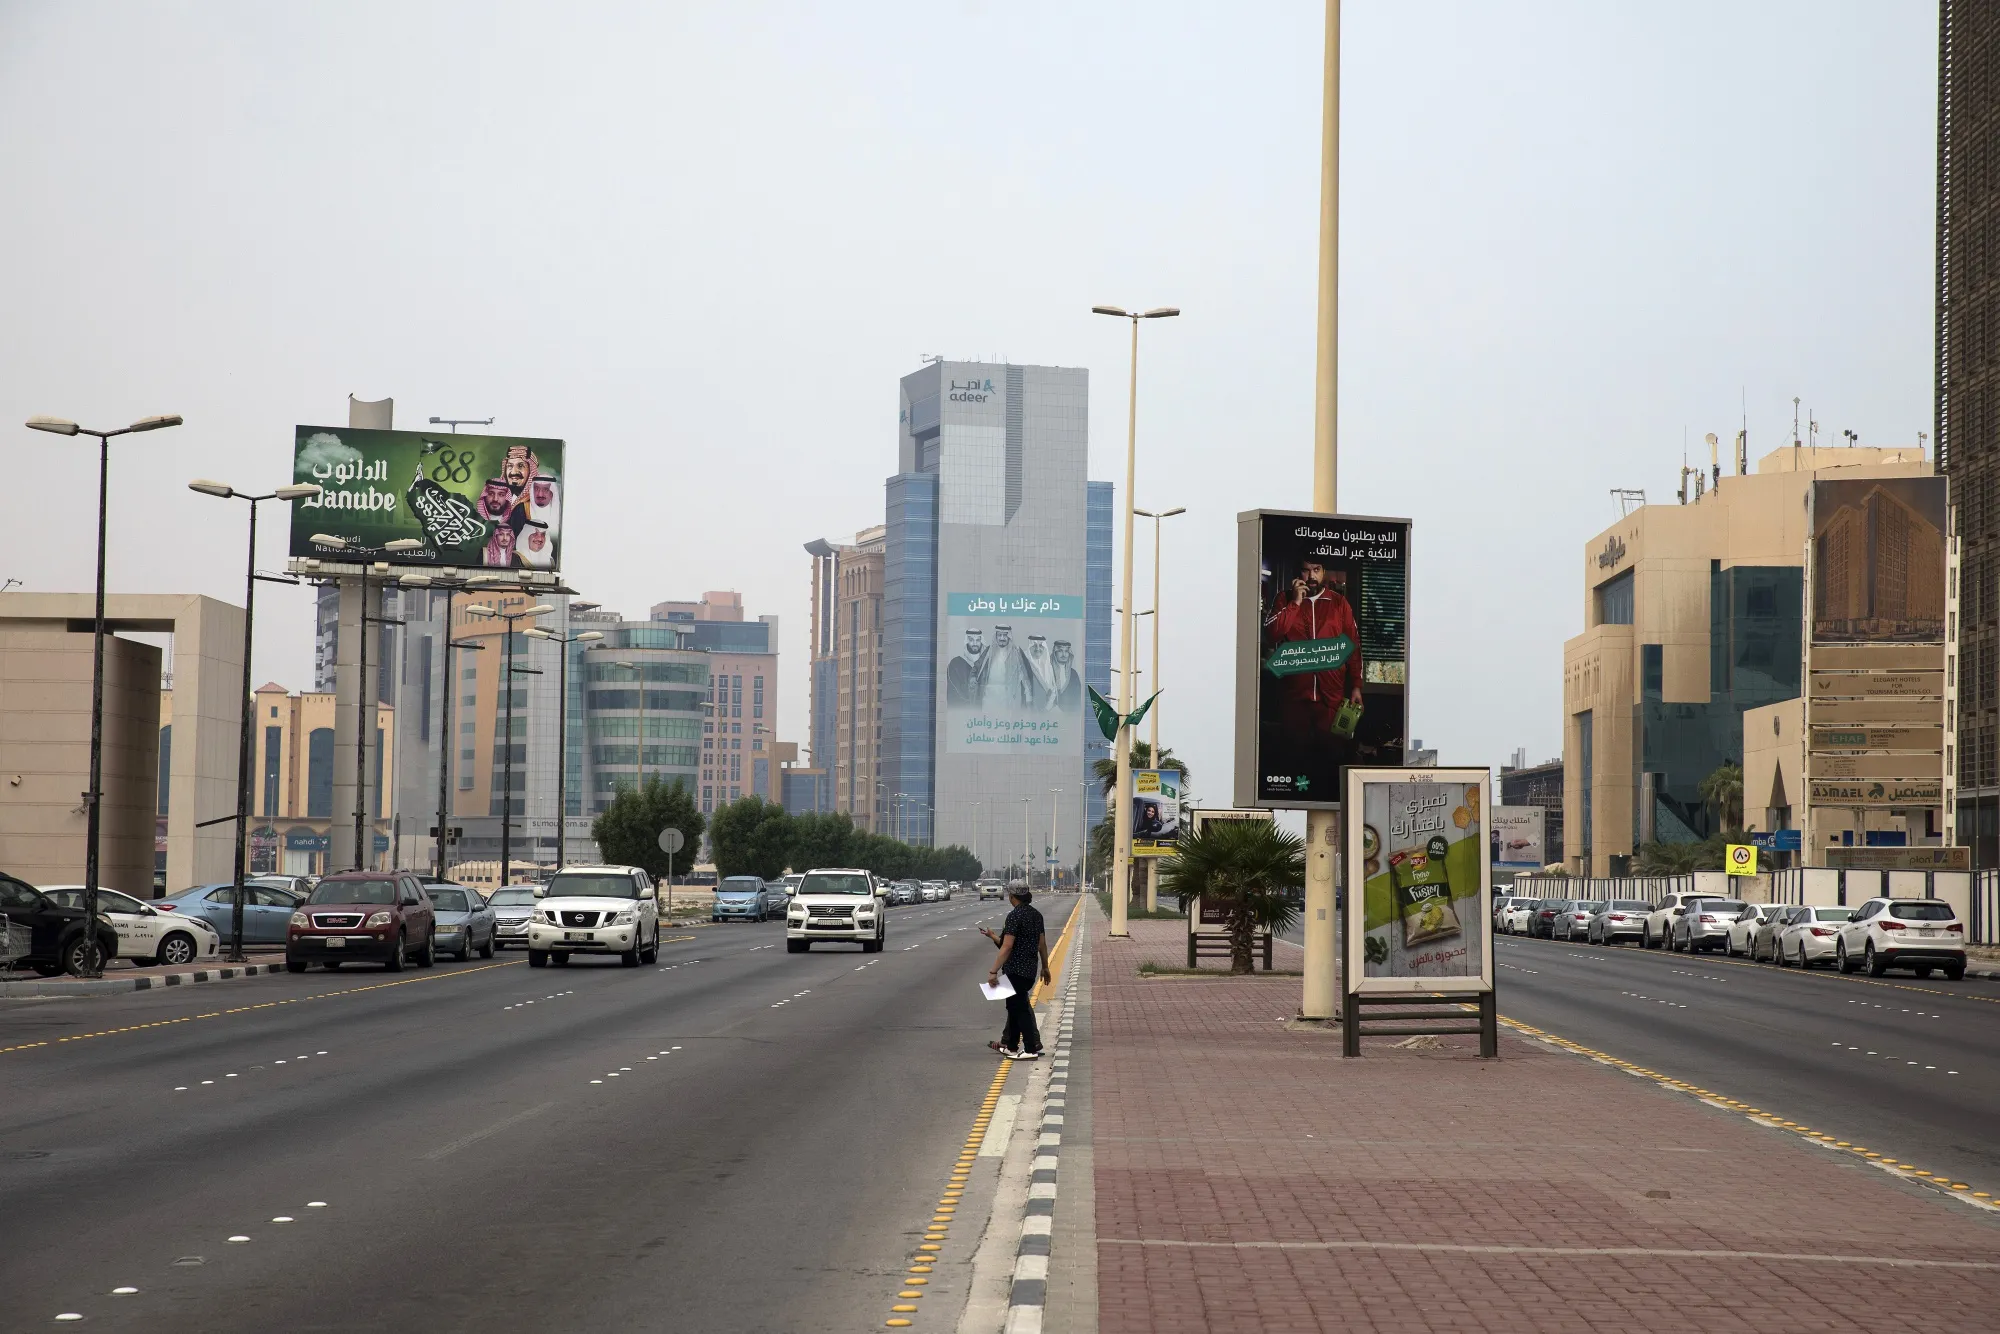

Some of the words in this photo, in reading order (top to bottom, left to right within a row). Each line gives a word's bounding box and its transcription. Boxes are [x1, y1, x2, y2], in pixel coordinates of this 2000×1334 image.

[950, 391, 988, 403] adeer
[312, 457, 388, 485] الدانوب
[432, 450, 475, 483] 88
[301, 484, 396, 511] Danube
[415, 495, 433, 517] 88
[1294, 526, 1340, 541] معلوماتك
[1342, 529, 1376, 544] يطلبون
[1378, 532, 1397, 545] اللي
[1349, 549, 1365, 560] عبر
[1368, 547, 1397, 562] البنكية
[968, 597, 996, 613] وطن
[999, 597, 1008, 613] يا
[1011, 597, 1037, 613] عزك
[1039, 598, 1060, 614] دام
[1272, 659, 1288, 667] منك
[1288, 657, 1319, 667] يسحبون
[1326, 653, 1340, 663] قبل
[966, 715, 992, 729] وأمان
[994, 718, 1011, 730] وعز
[1012, 719, 1037, 730] وحزم
[1039, 719, 1059, 730] عزم
[966, 733, 995, 744] سلمان
[997, 734, 1022, 744] الملك
[1024, 736, 1042, 746] عهد
[1043, 735, 1059, 744] هذا
[1832, 735, 1863, 743] EHAF
[1812, 787, 1864, 797] ASMAEL
[1405, 792, 1447, 817] تميزي
[1509, 816, 1531, 824] امتلك
[1391, 814, 1445, 839] باختيارك
[1431, 841, 1445, 850] 60%
[1736, 851, 1748, 860] ٨٠
[1909, 855, 1930, 865] plan
[1409, 884, 1441, 901] Fusion
[1408, 952, 1434, 969] بالفرن
